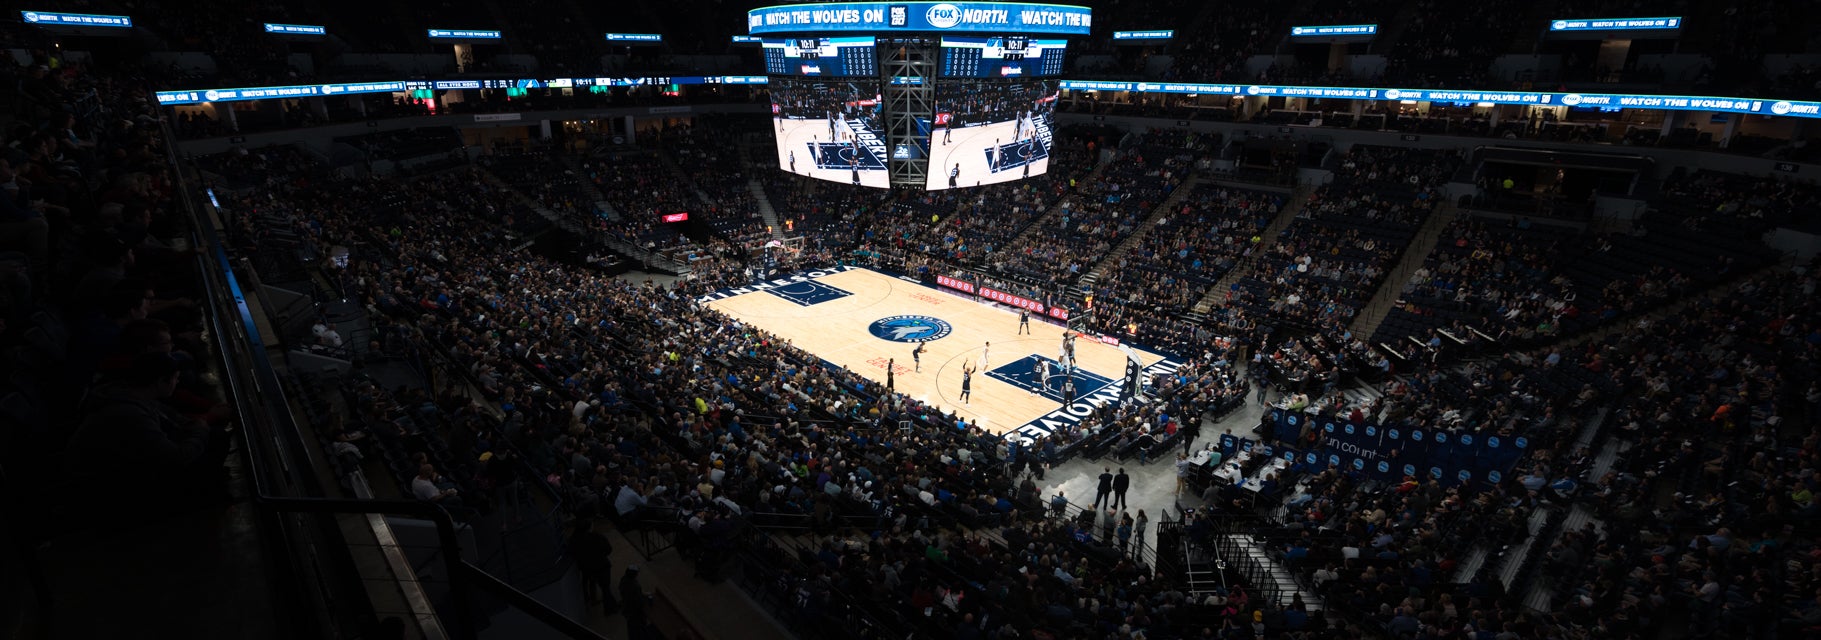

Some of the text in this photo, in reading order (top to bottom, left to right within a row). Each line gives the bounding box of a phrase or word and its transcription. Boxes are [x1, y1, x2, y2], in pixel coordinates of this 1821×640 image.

[766, 12, 790, 26] WATCH
[792, 11, 811, 24] THE
[813, 10, 860, 24] WOLVES
[863, 9, 884, 23] ON
[934, 9, 954, 19] FOX
[1021, 10, 1063, 26] WATCH
[1065, 12, 1081, 27] THE
[800, 39, 815, 49] 10:11
[1008, 40, 1023, 50] 10:11
[997, 47, 1002, 57] 2
[176, 93, 189, 101] ON
[241, 90, 265, 98] WATCH
[278, 88, 301, 96] WOLVES
[1429, 92, 1460, 100] WATCH
[1462, 93, 1480, 101] THE
[1482, 94, 1521, 102] WOLVES
[1620, 98, 1749, 110] WATCH THE WOLVES ON
[878, 315, 934, 324] MINNESOTA
[866, 359, 905, 377] CENER
